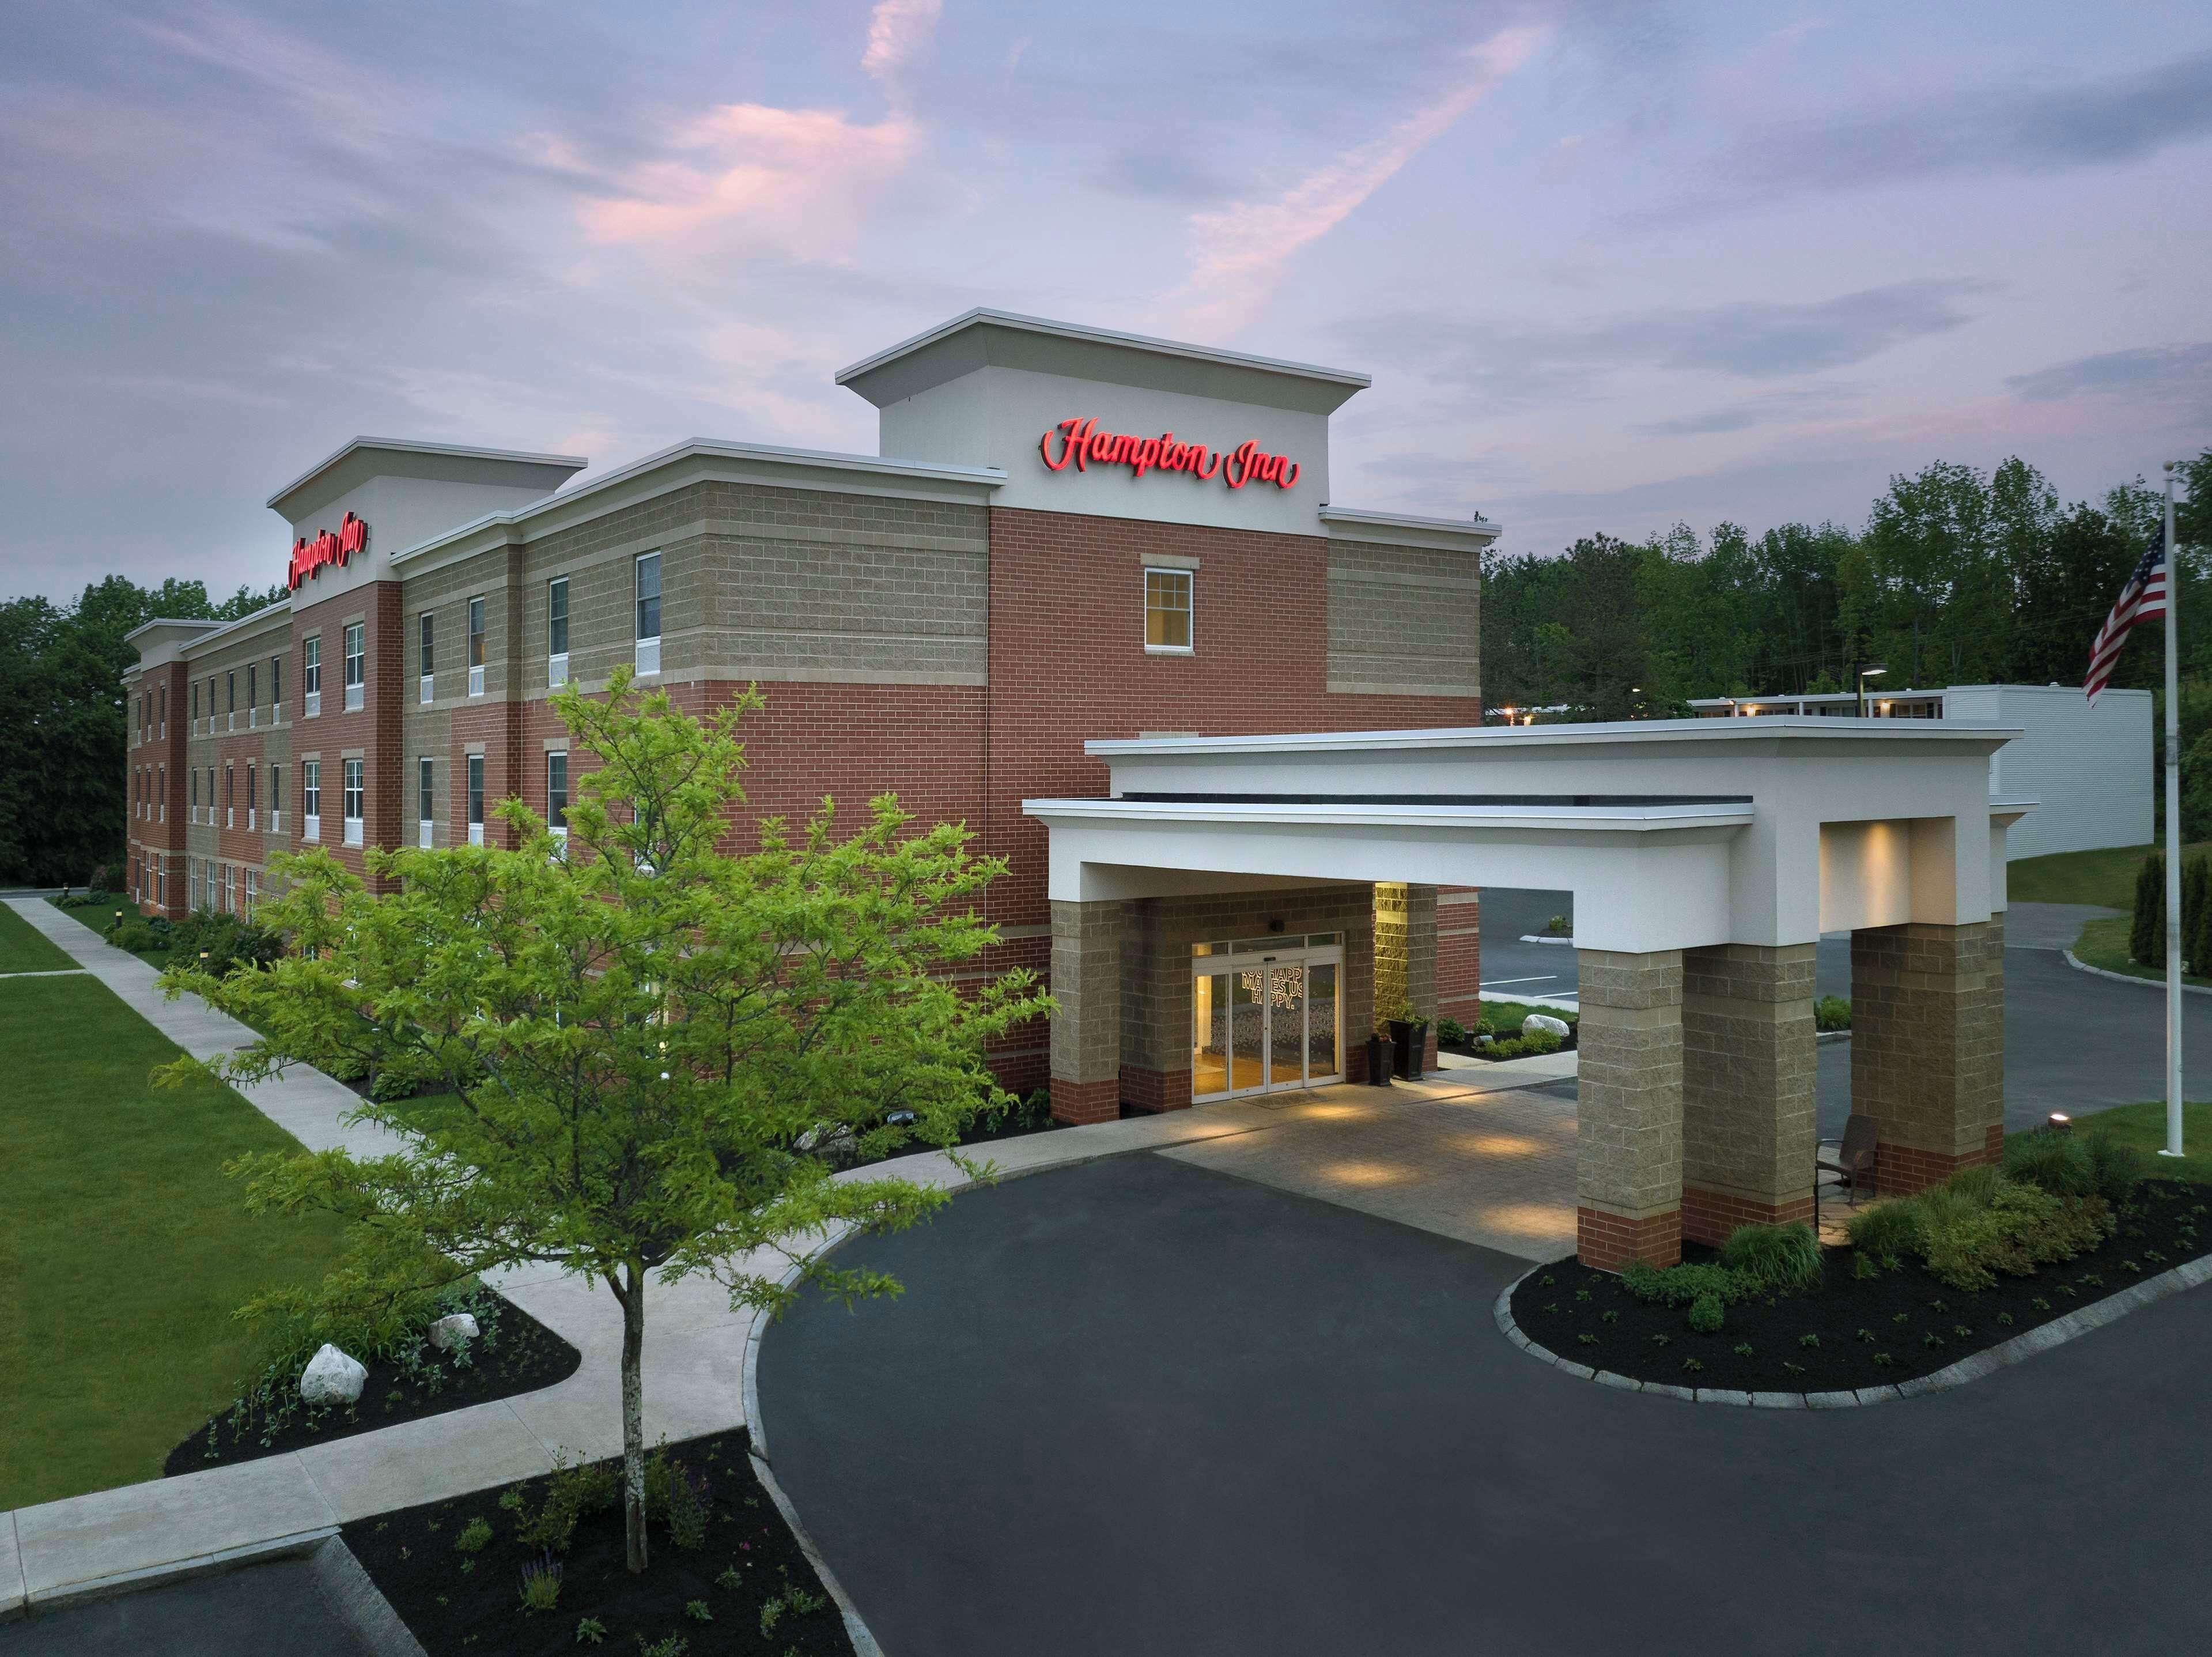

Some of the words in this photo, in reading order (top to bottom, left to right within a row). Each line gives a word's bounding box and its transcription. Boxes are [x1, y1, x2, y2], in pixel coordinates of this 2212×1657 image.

[1039, 416, 1220, 480] Hampton
[1223, 439, 1300, 489] Inn
[288, 529, 335, 591] Hampton
[336, 511, 367, 568] Inn
[1242, 974, 1286, 993] MAES
